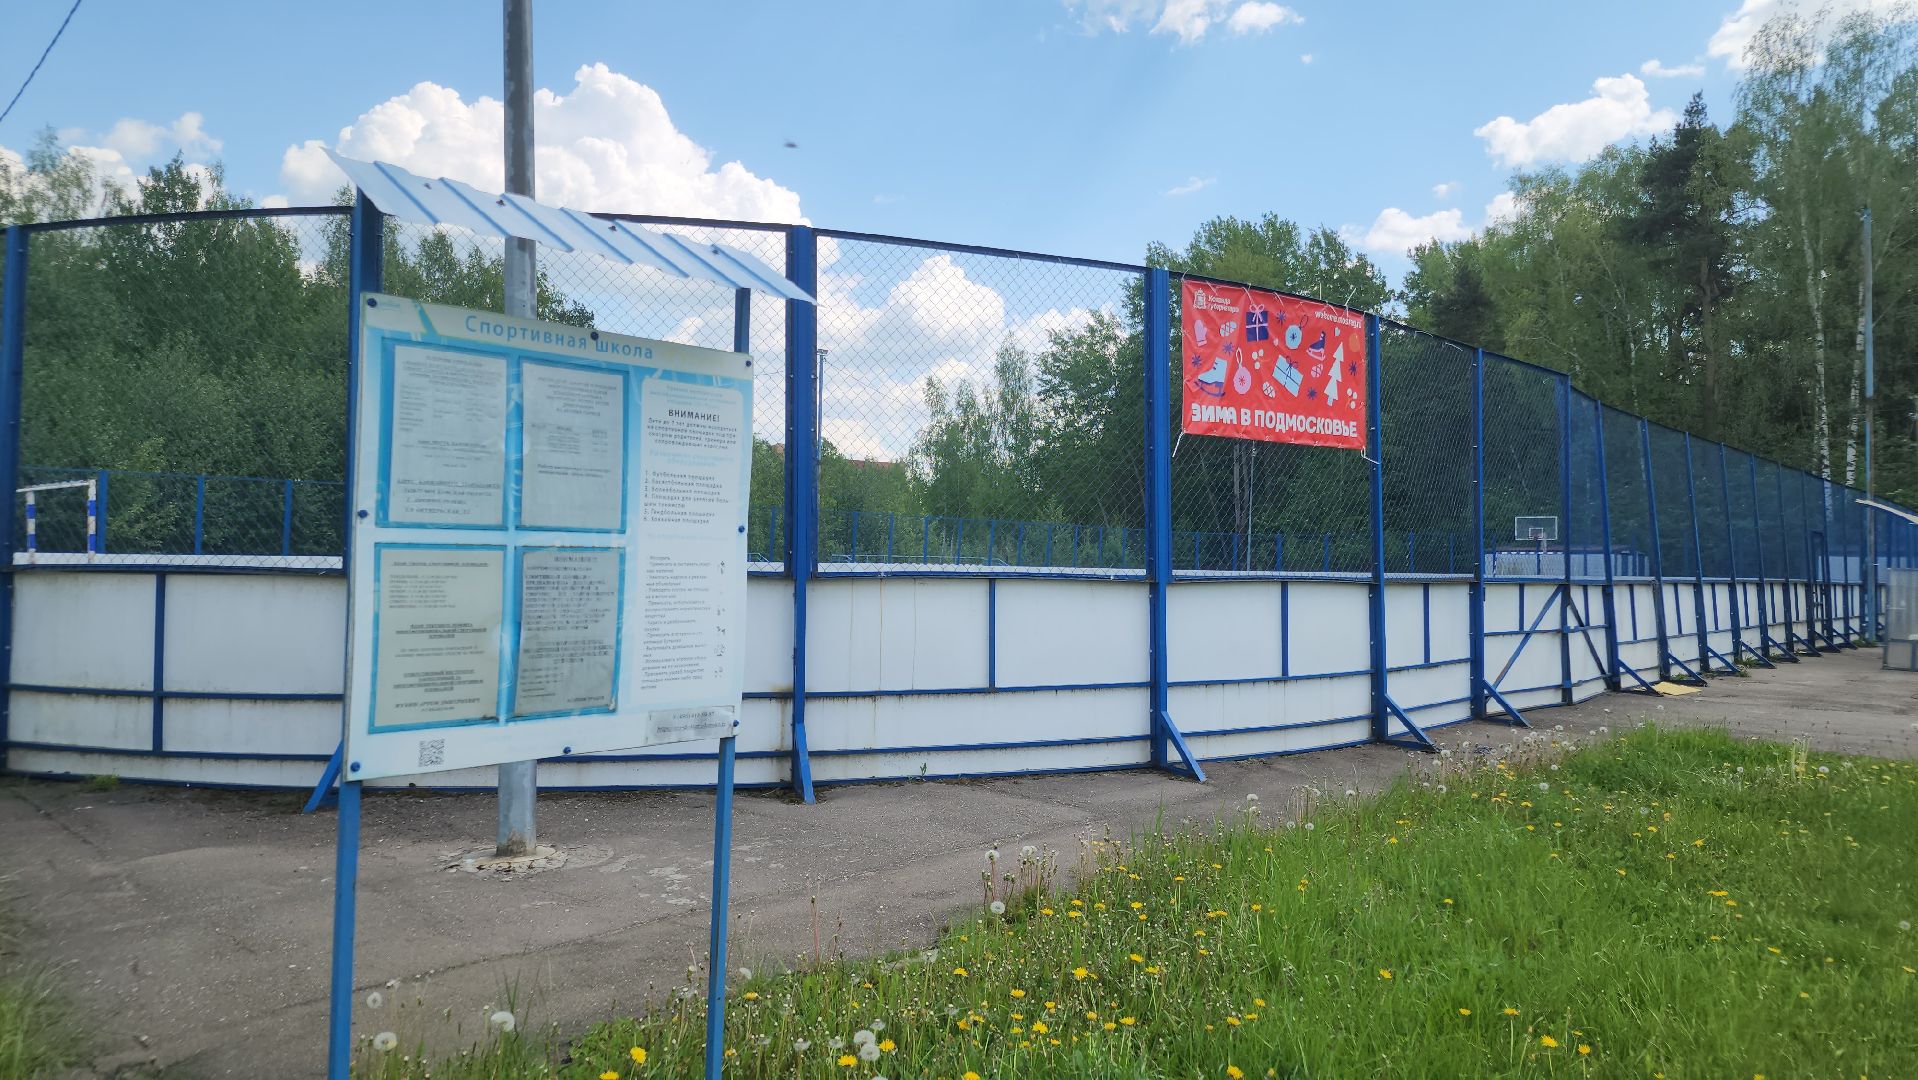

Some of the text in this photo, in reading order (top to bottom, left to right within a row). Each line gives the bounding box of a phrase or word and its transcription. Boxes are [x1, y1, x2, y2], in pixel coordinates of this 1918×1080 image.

[464, 314, 655, 361] Спортивная школа
[668, 409, 720, 422] ВНИМАНИЕ!
[1191, 402, 1358, 438] ЗИМА В ПОДМОСКОВЬЕ
